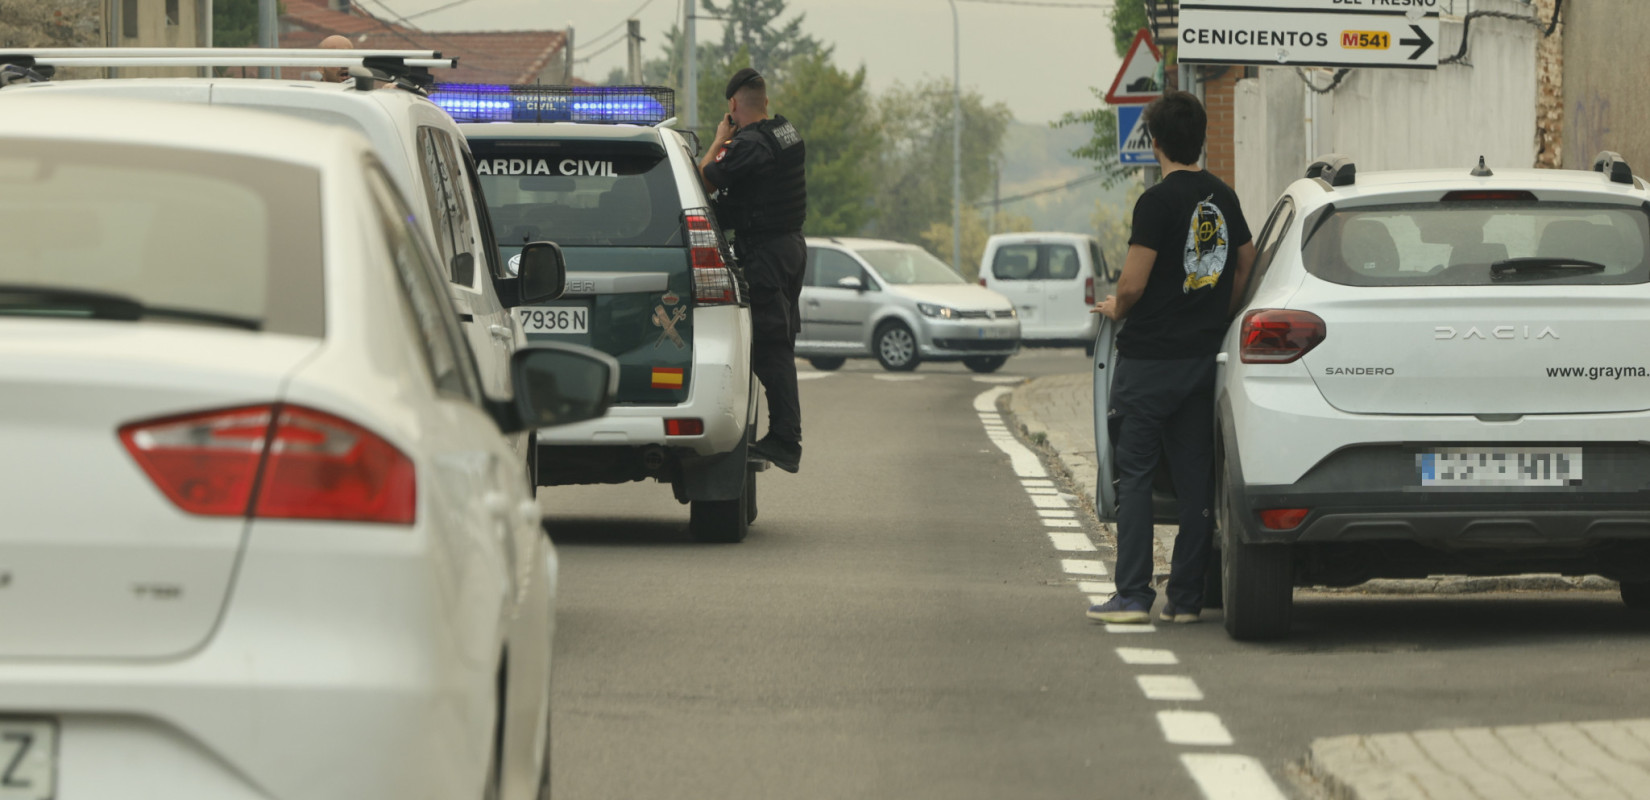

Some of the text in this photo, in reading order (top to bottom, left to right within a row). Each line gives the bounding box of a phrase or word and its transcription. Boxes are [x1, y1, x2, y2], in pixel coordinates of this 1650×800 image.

[1182, 28, 1389, 48] CENICIENTOS M541
[526, 102, 556, 110] CIVIL
[475, 159, 618, 178] ARDIA CIVIL
[520, 310, 585, 330] 7936 N
[1434, 325, 1560, 340] DACIA
[1325, 367, 1395, 376] SANDERO
[1546, 367, 1650, 381] www.grayma.
